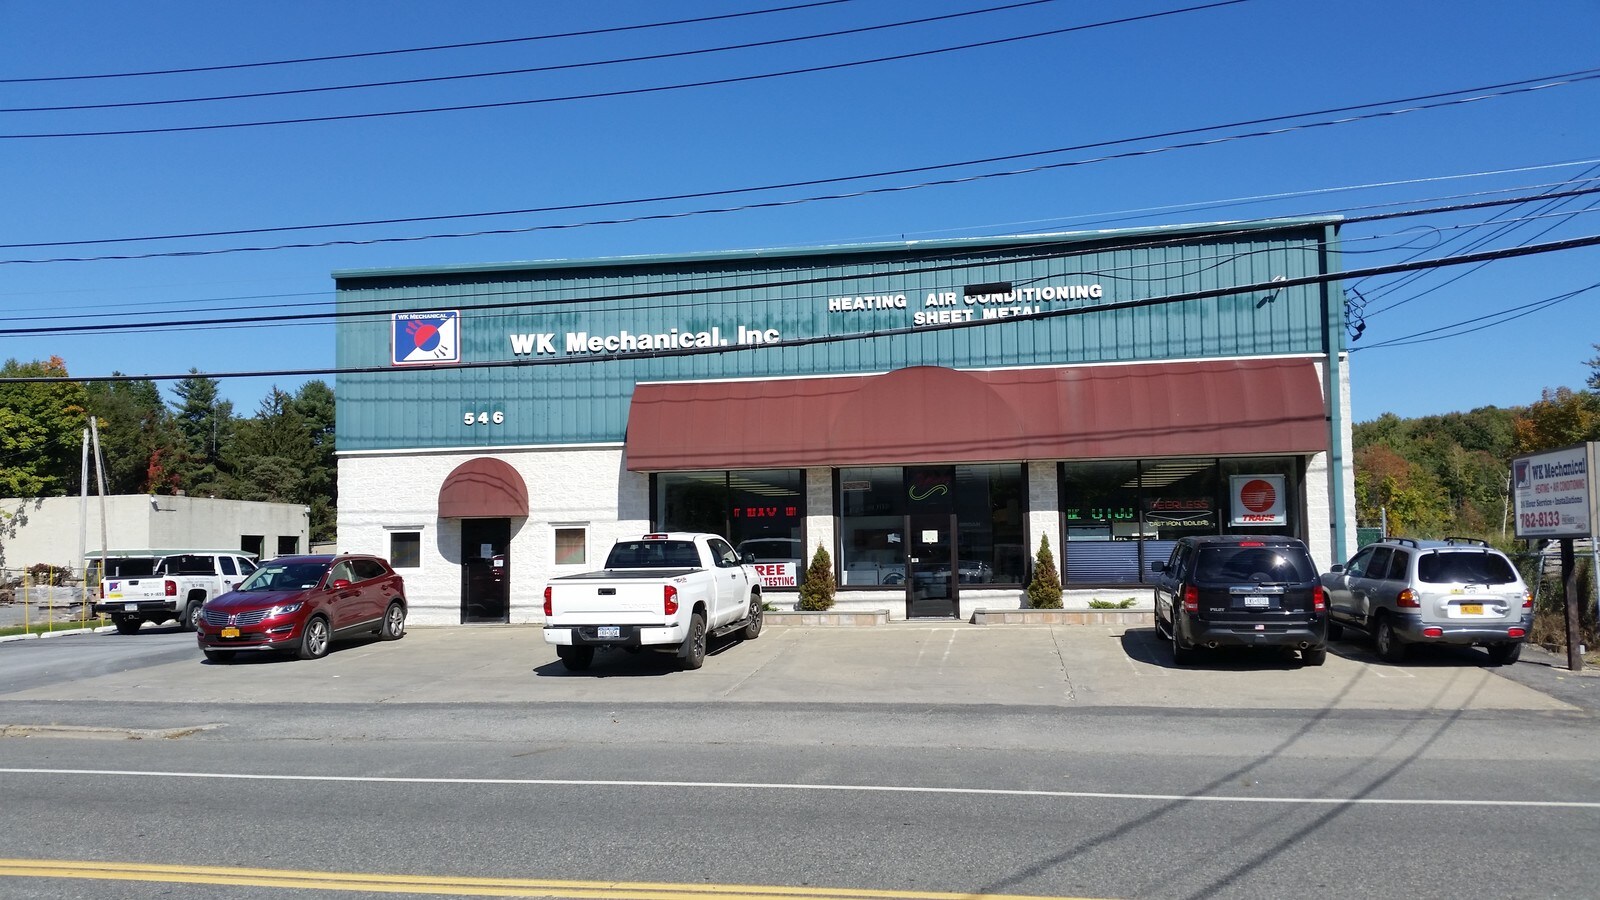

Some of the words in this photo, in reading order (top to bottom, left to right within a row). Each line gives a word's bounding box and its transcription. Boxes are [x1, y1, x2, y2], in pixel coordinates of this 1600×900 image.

[828, 294, 907, 312] HEATING
[925, 292, 957, 307] AIR
[963, 284, 1103, 305] CONDITIONING
[913, 311, 974, 325] SHEET
[509, 333, 556, 356] WK
[738, 325, 781, 345] Inc
[463, 410, 505, 426] 546
[1532, 465, 1544, 480] WK
[1545, 458, 1586, 478] Mechanical
[1150, 500, 1209, 510] PEERLESS
[1520, 511, 1560, 528] 782-8133
[754, 565, 785, 576] REE
[764, 577, 795, 586] TESTING
